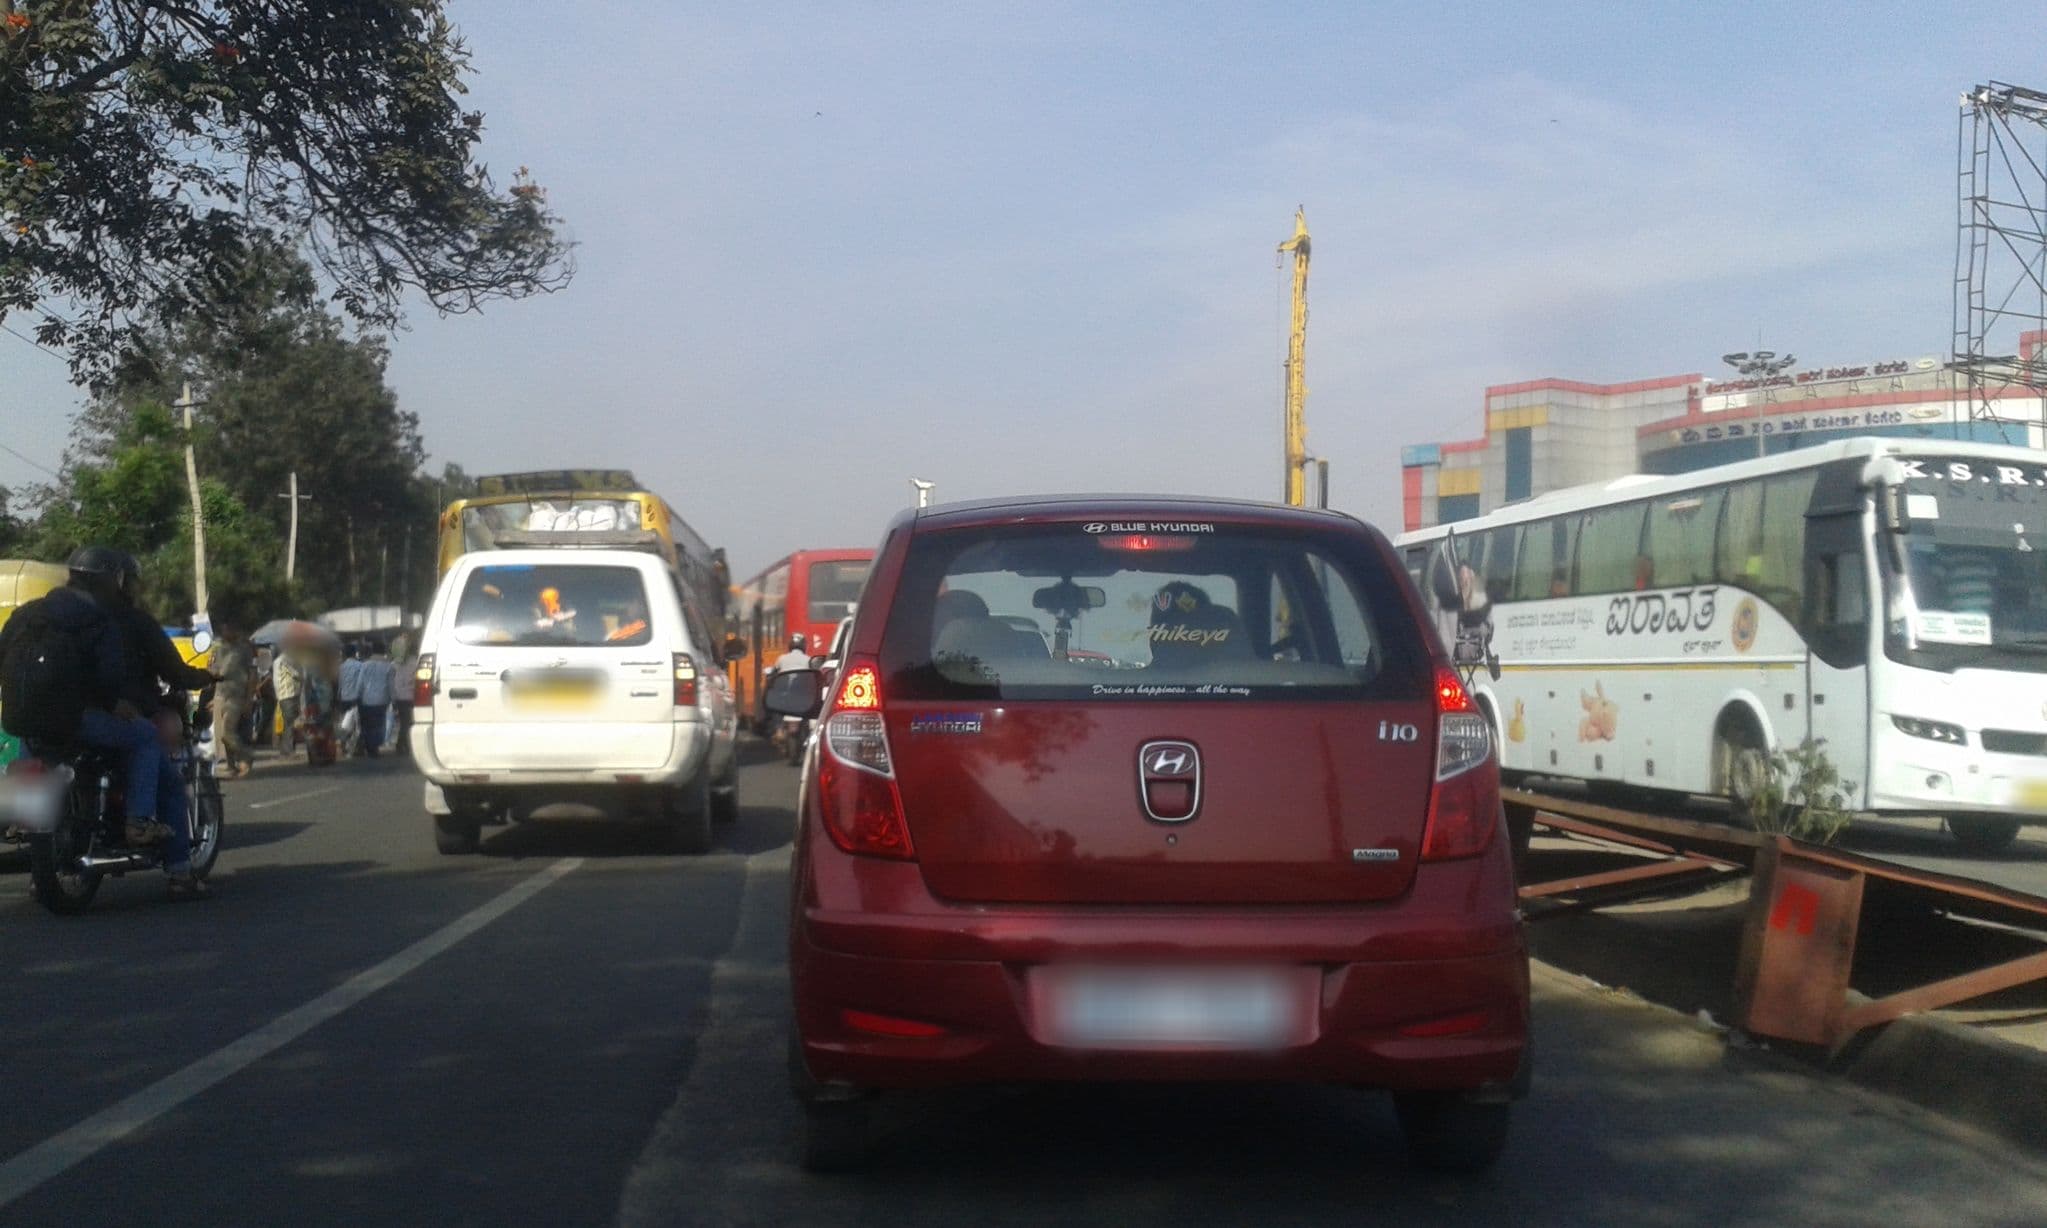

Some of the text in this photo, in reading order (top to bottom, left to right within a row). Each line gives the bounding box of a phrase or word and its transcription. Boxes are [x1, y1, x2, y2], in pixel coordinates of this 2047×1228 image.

[1897, 460, 2047, 487] K.S.R.
[1110, 523, 1214, 533] BLUE HYUNDAI
[1092, 684, 1122, 695] Drive
[1124, 685, 1135, 695] in
[1213, 684, 1228, 694] the
[1230, 686, 1250, 697] way
